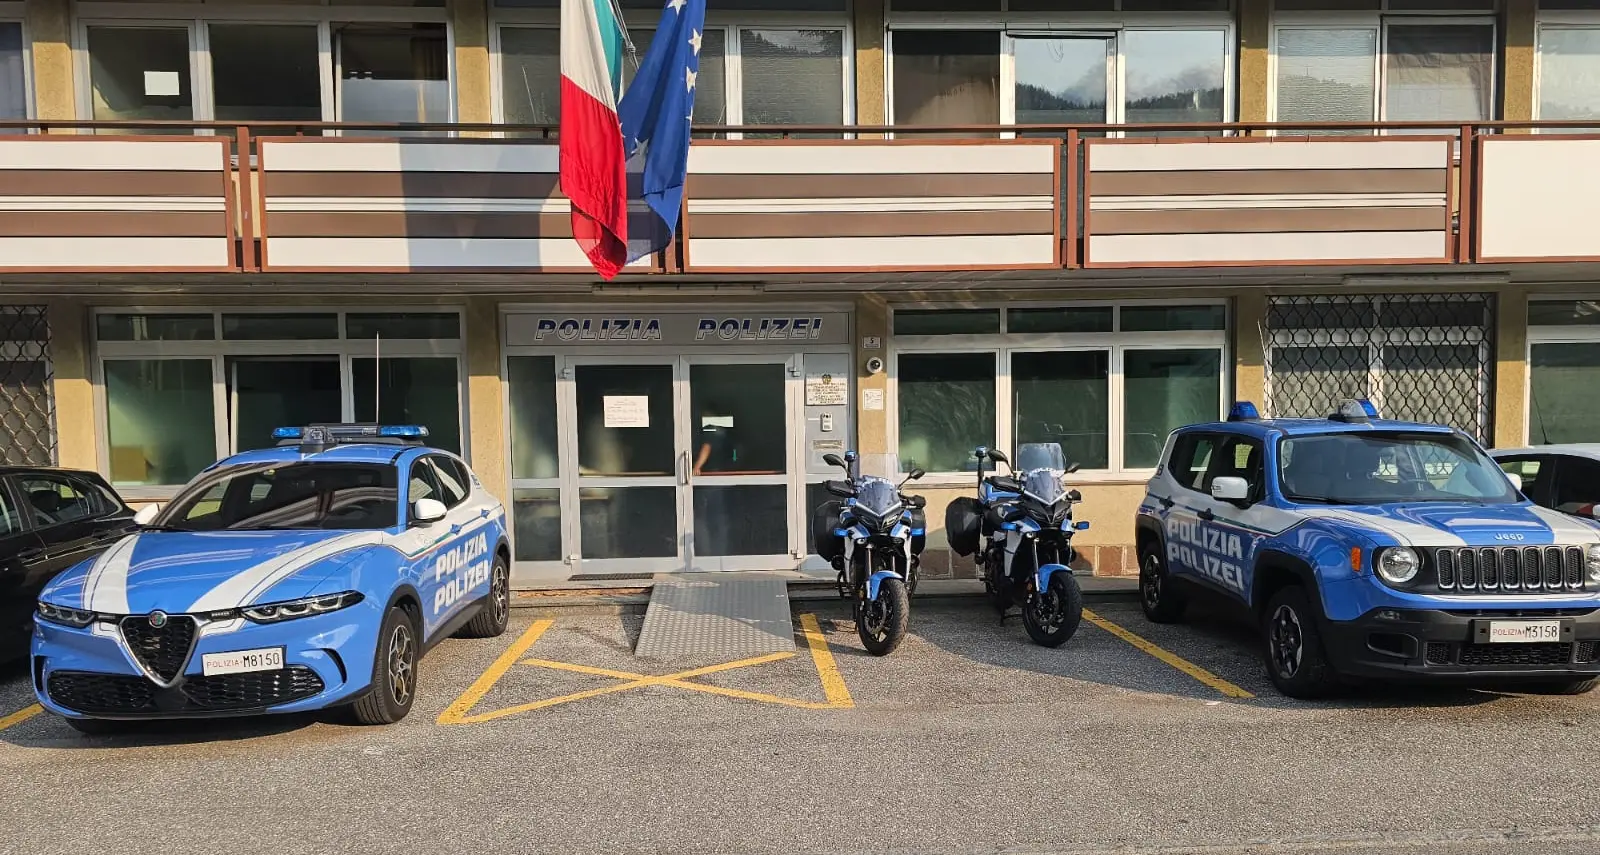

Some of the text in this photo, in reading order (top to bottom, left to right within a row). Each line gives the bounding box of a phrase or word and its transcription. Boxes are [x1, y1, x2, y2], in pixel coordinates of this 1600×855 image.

[534, 317, 823, 341] POLIZIA POLIZEI
[1167, 518, 1243, 560] POLIZIA
[1495, 533, 1524, 541] Jeep
[435, 531, 488, 583] POLIZIA
[1166, 541, 1245, 592] POLIZEI
[434, 559, 489, 615] POLIZEI
[1492, 625, 1558, 639] POLIZIA M3158
[206, 652, 280, 669] POLIZIA M8150
